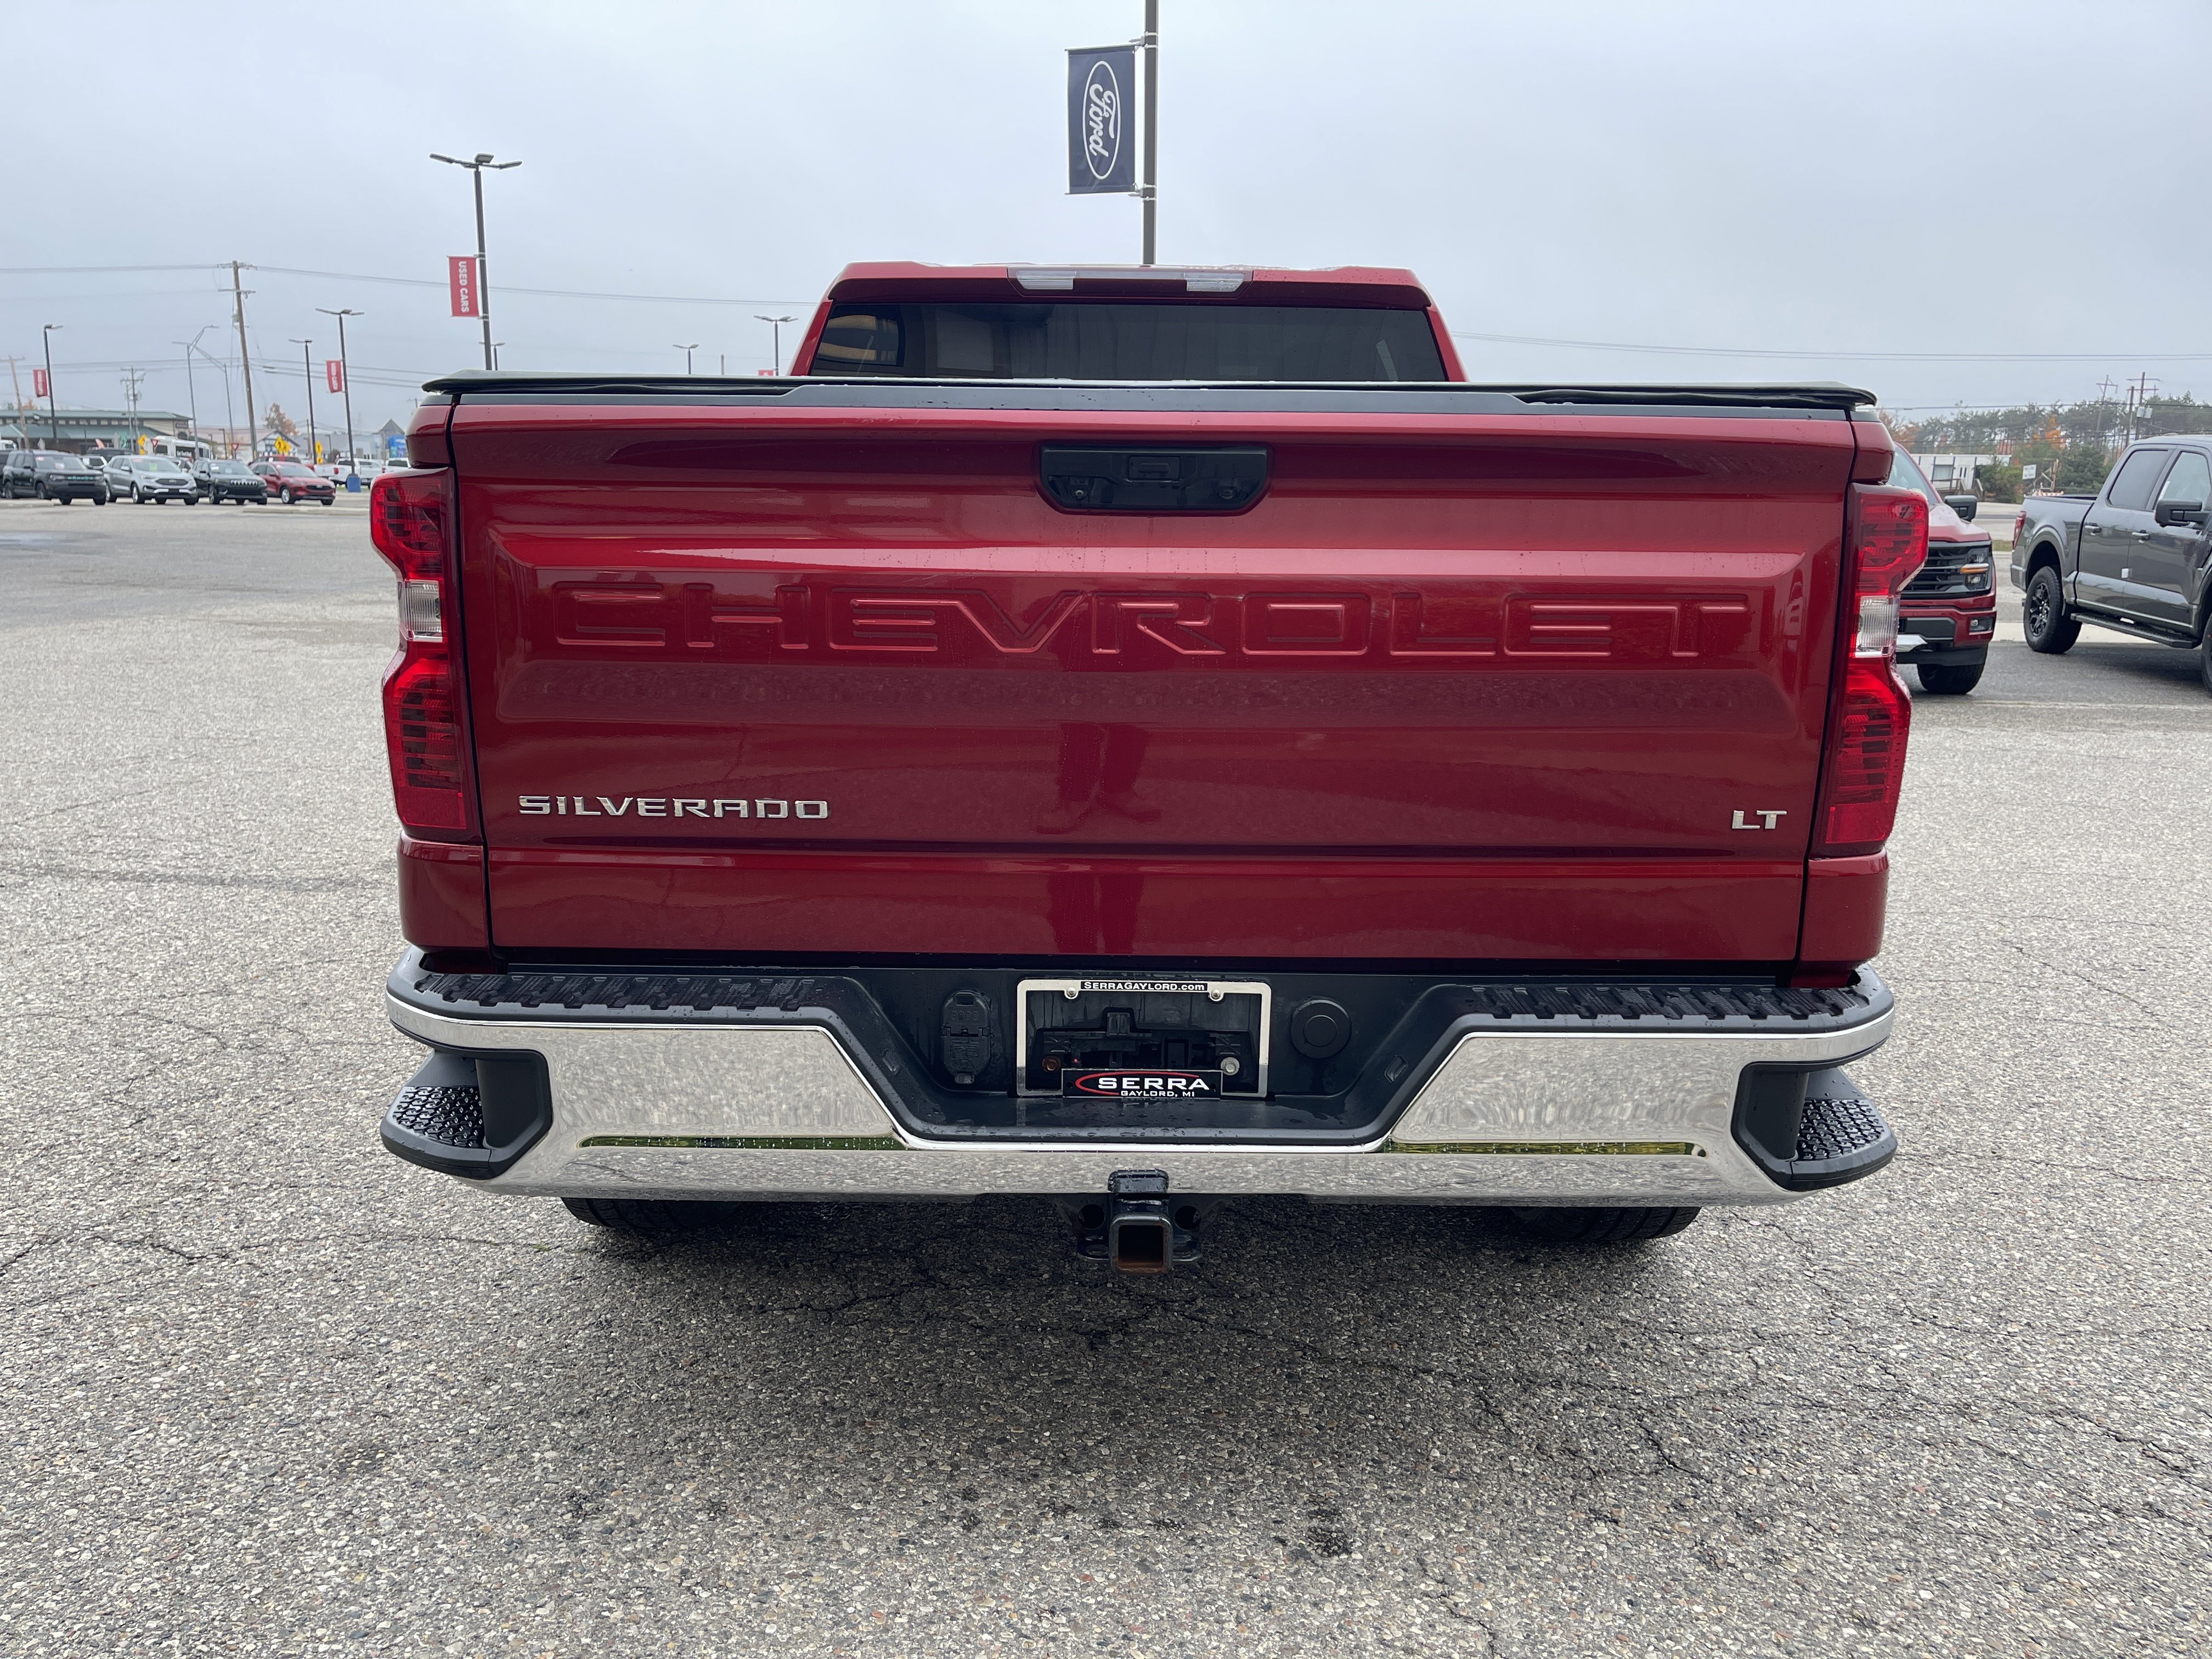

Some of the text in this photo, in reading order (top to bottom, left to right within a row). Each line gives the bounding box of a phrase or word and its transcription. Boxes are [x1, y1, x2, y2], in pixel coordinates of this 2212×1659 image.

[1089, 83, 1116, 157] Ford
[459, 261, 470, 313] USED CARS
[554, 580, 1748, 657] CHEVROLET
[518, 795, 829, 819] SILVERADO
[1731, 810, 1787, 829] LT
[1084, 981, 1205, 990] SERRAGAYLORD.com
[1098, 1077, 1210, 1090] SERRA
